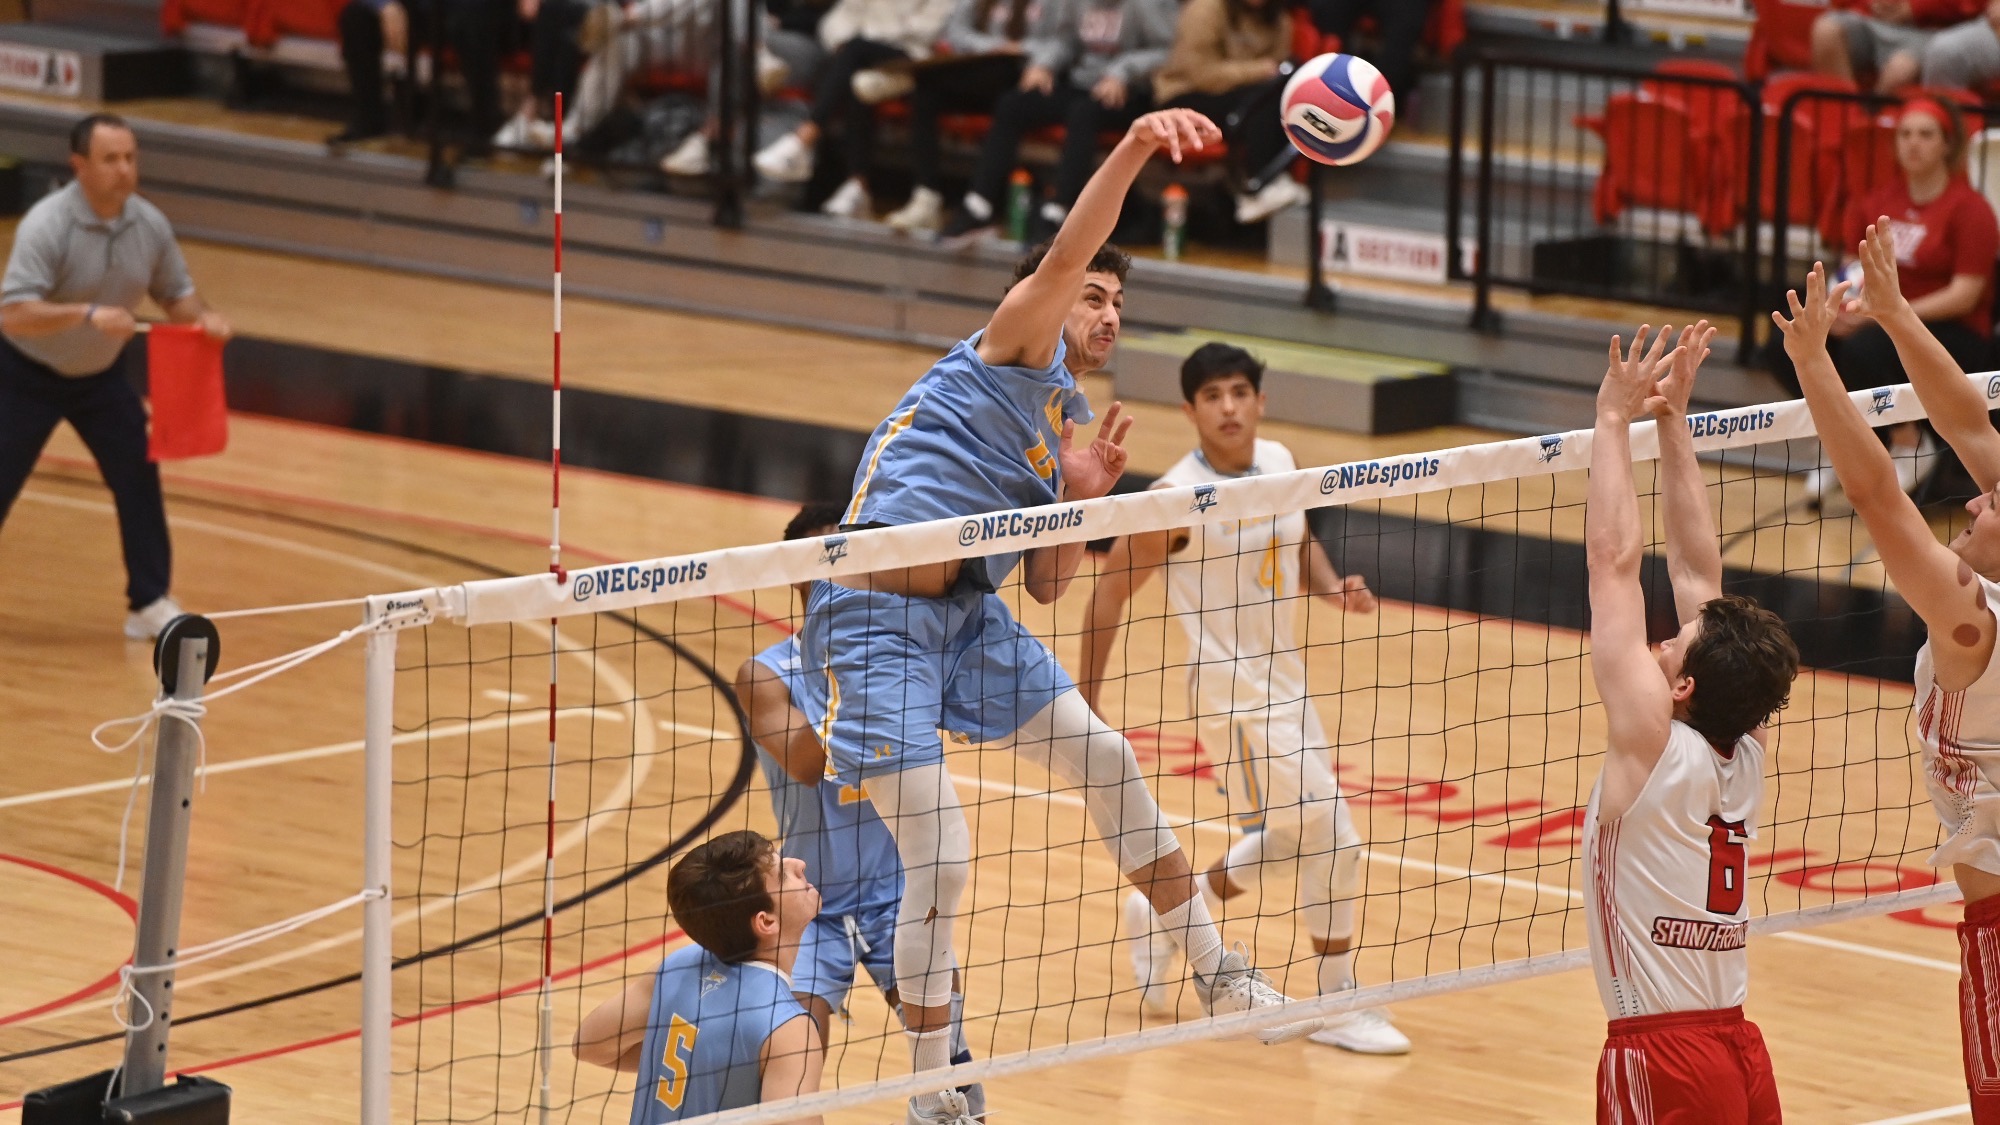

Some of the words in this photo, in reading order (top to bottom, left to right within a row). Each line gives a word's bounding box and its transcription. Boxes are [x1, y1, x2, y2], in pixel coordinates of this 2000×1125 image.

[1687, 409, 1775, 439] ECsports
[1320, 457, 1440, 495] @NECsports
[958, 506, 1084, 547] @NECsports
[573, 560, 708, 602] @NECsports
[1705, 815, 1749, 915] 6
[1652, 917, 1715, 950] SAINT
[655, 1012, 700, 1112] 5
